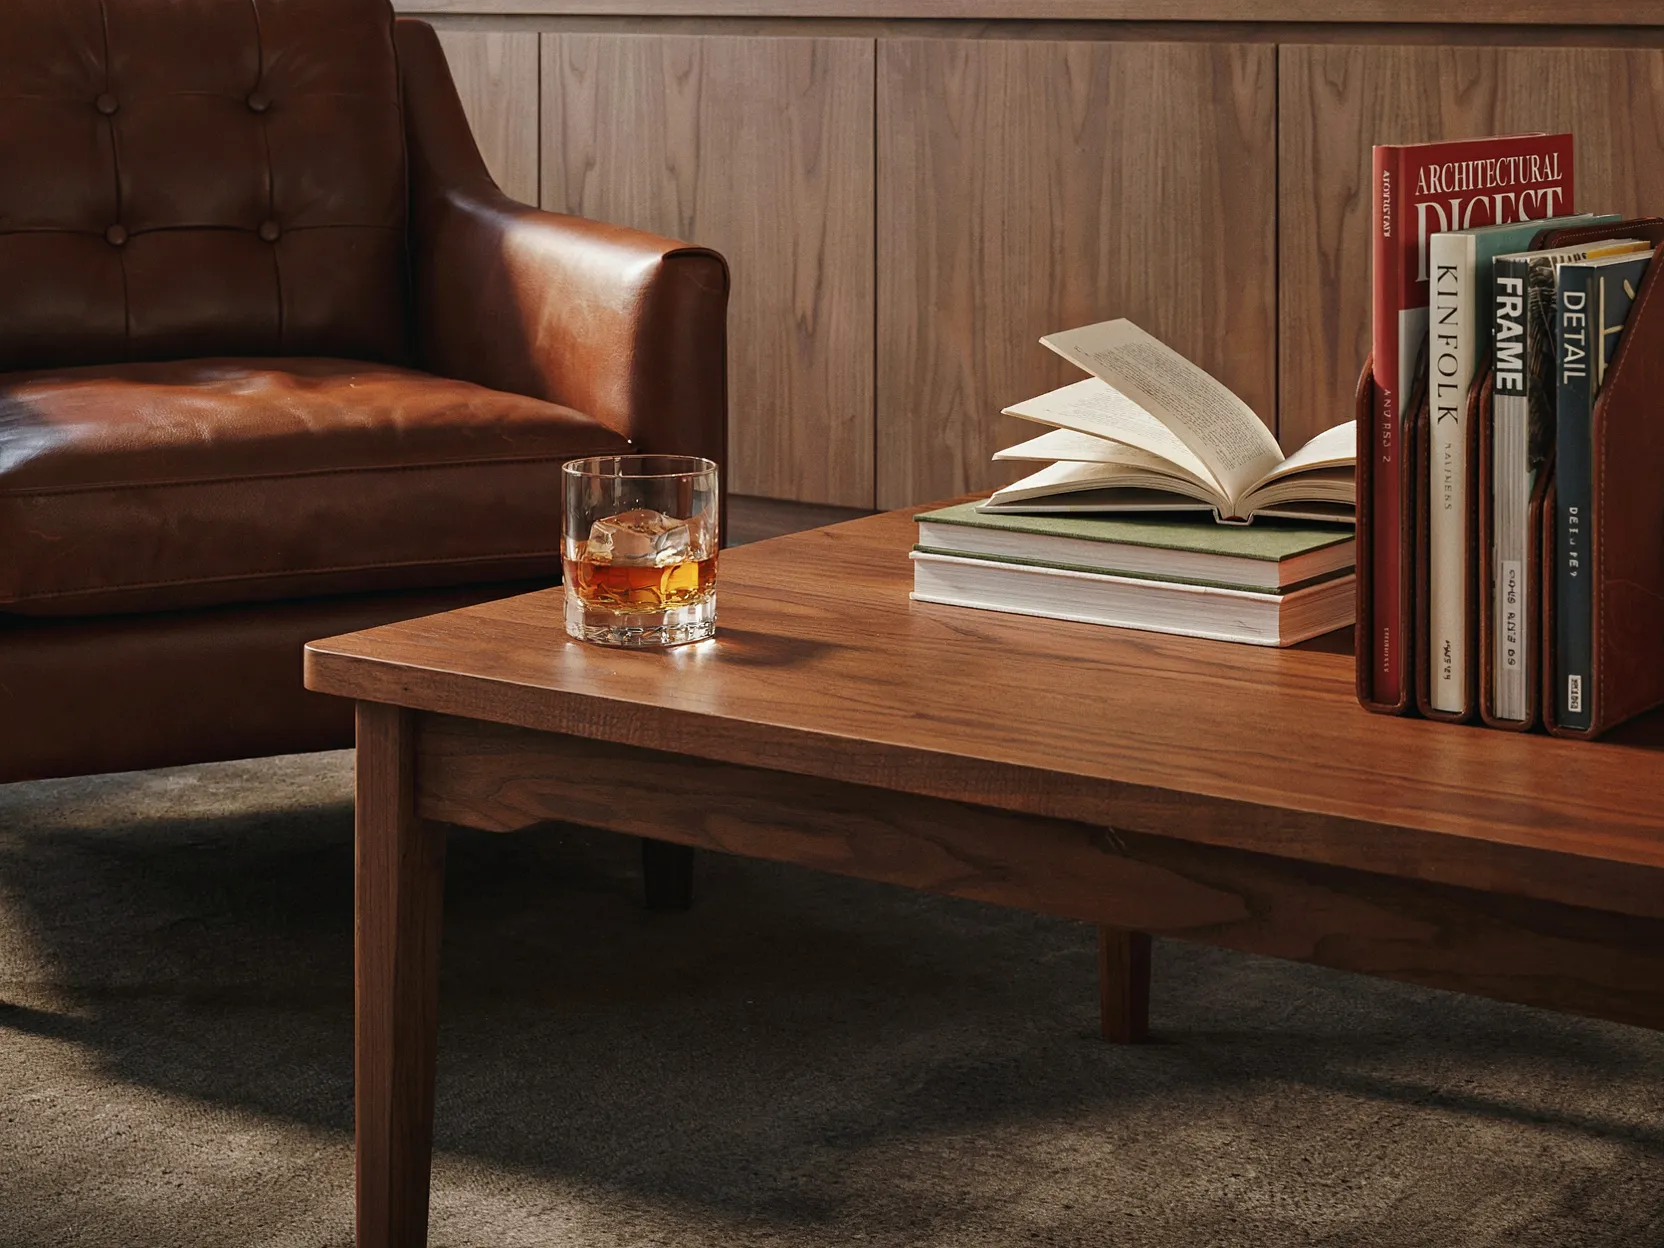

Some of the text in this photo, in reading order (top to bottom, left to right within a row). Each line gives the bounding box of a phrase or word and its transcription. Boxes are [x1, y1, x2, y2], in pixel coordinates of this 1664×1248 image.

[1415, 152, 1563, 195] ARCHITECTURAL
[1437, 265, 1459, 424] KINFOLK
[1496, 277, 1524, 391] FRAME
[1563, 291, 1586, 385] DETAIL
